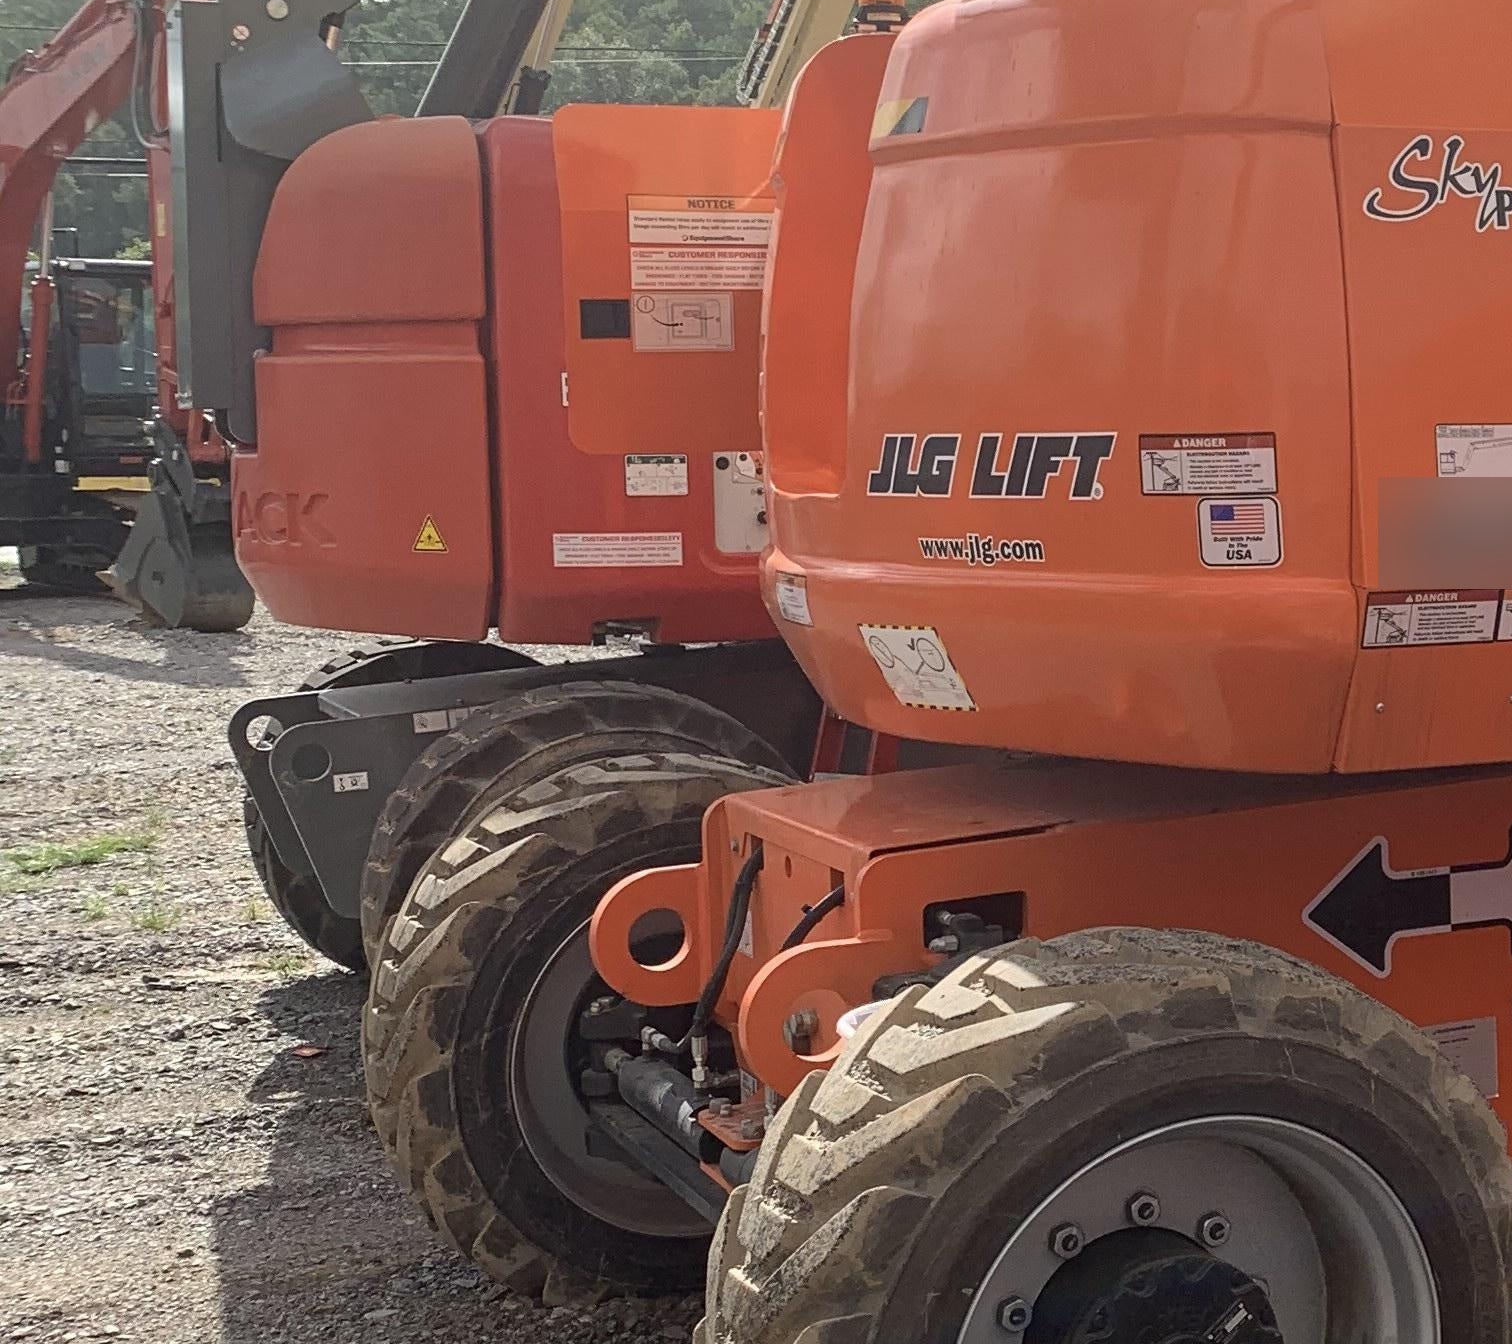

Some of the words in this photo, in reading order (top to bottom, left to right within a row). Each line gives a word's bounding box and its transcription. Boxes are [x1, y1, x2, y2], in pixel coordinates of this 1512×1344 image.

[688, 199, 736, 209] NOTICE
[1182, 437, 1227, 448] DANGER
[868, 434, 961, 496] JLG
[969, 433, 1116, 498] LIFT
[919, 535, 1044, 565] www.jlg.com
[1226, 549, 1252, 560] USA
[1414, 592, 1458, 603] DANGER
